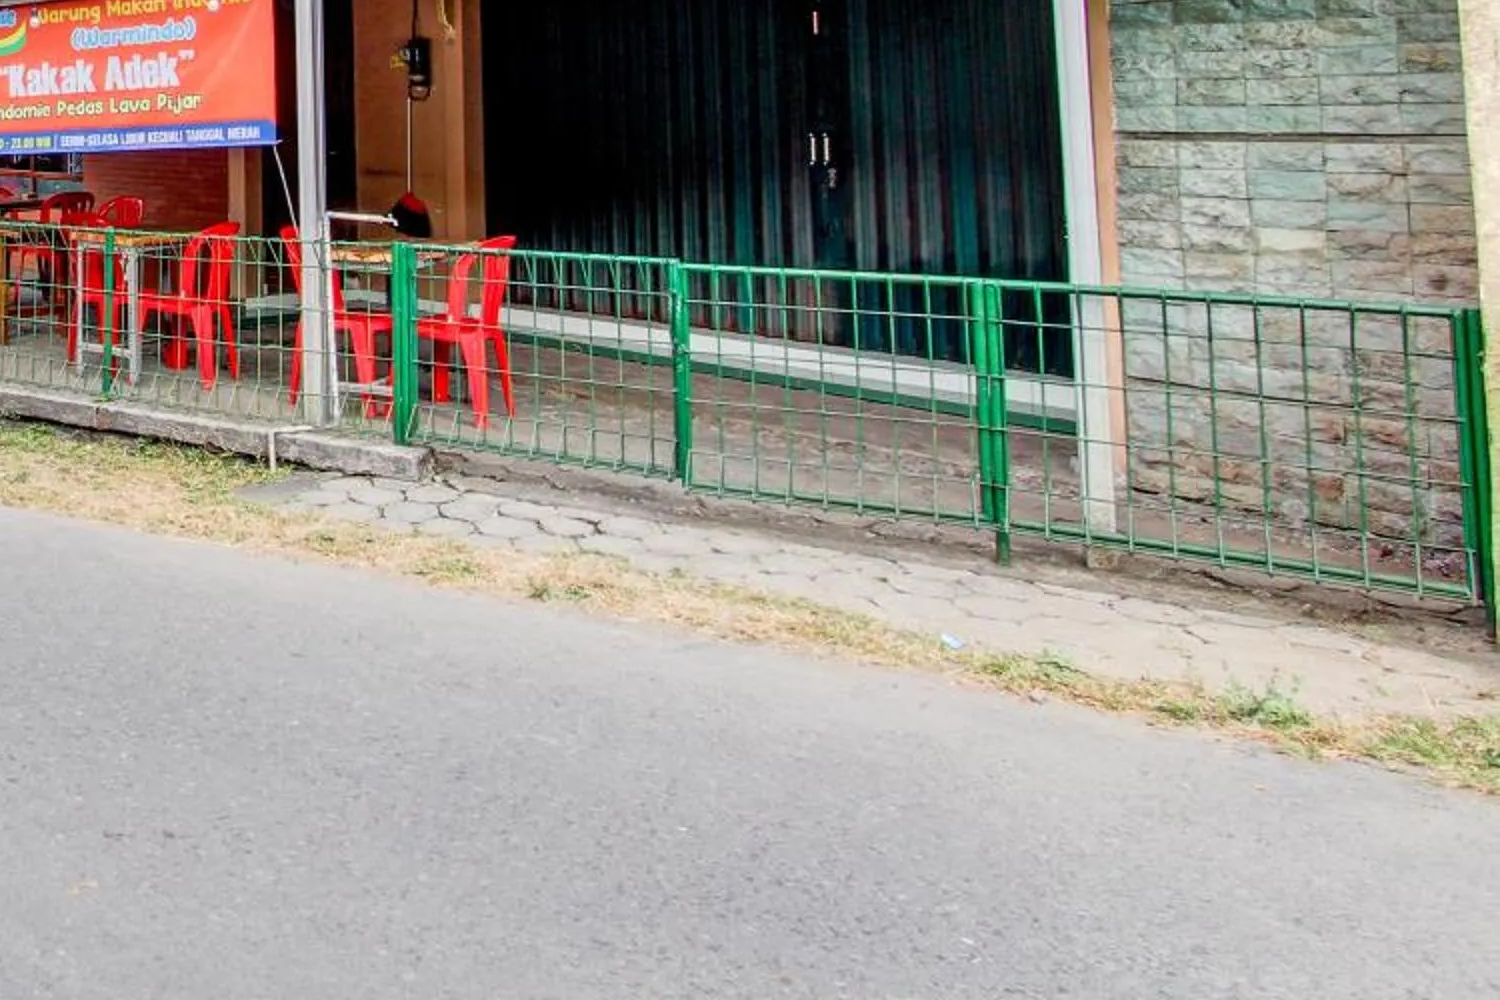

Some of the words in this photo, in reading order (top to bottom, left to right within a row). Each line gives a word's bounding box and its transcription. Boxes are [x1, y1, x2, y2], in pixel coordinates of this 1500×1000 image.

[71, 17, 197, 51] (Warmindo)
[56, 100, 104, 117] Pedas
[109, 97, 151, 113] Lava
[157, 92, 202, 114] Pijar
